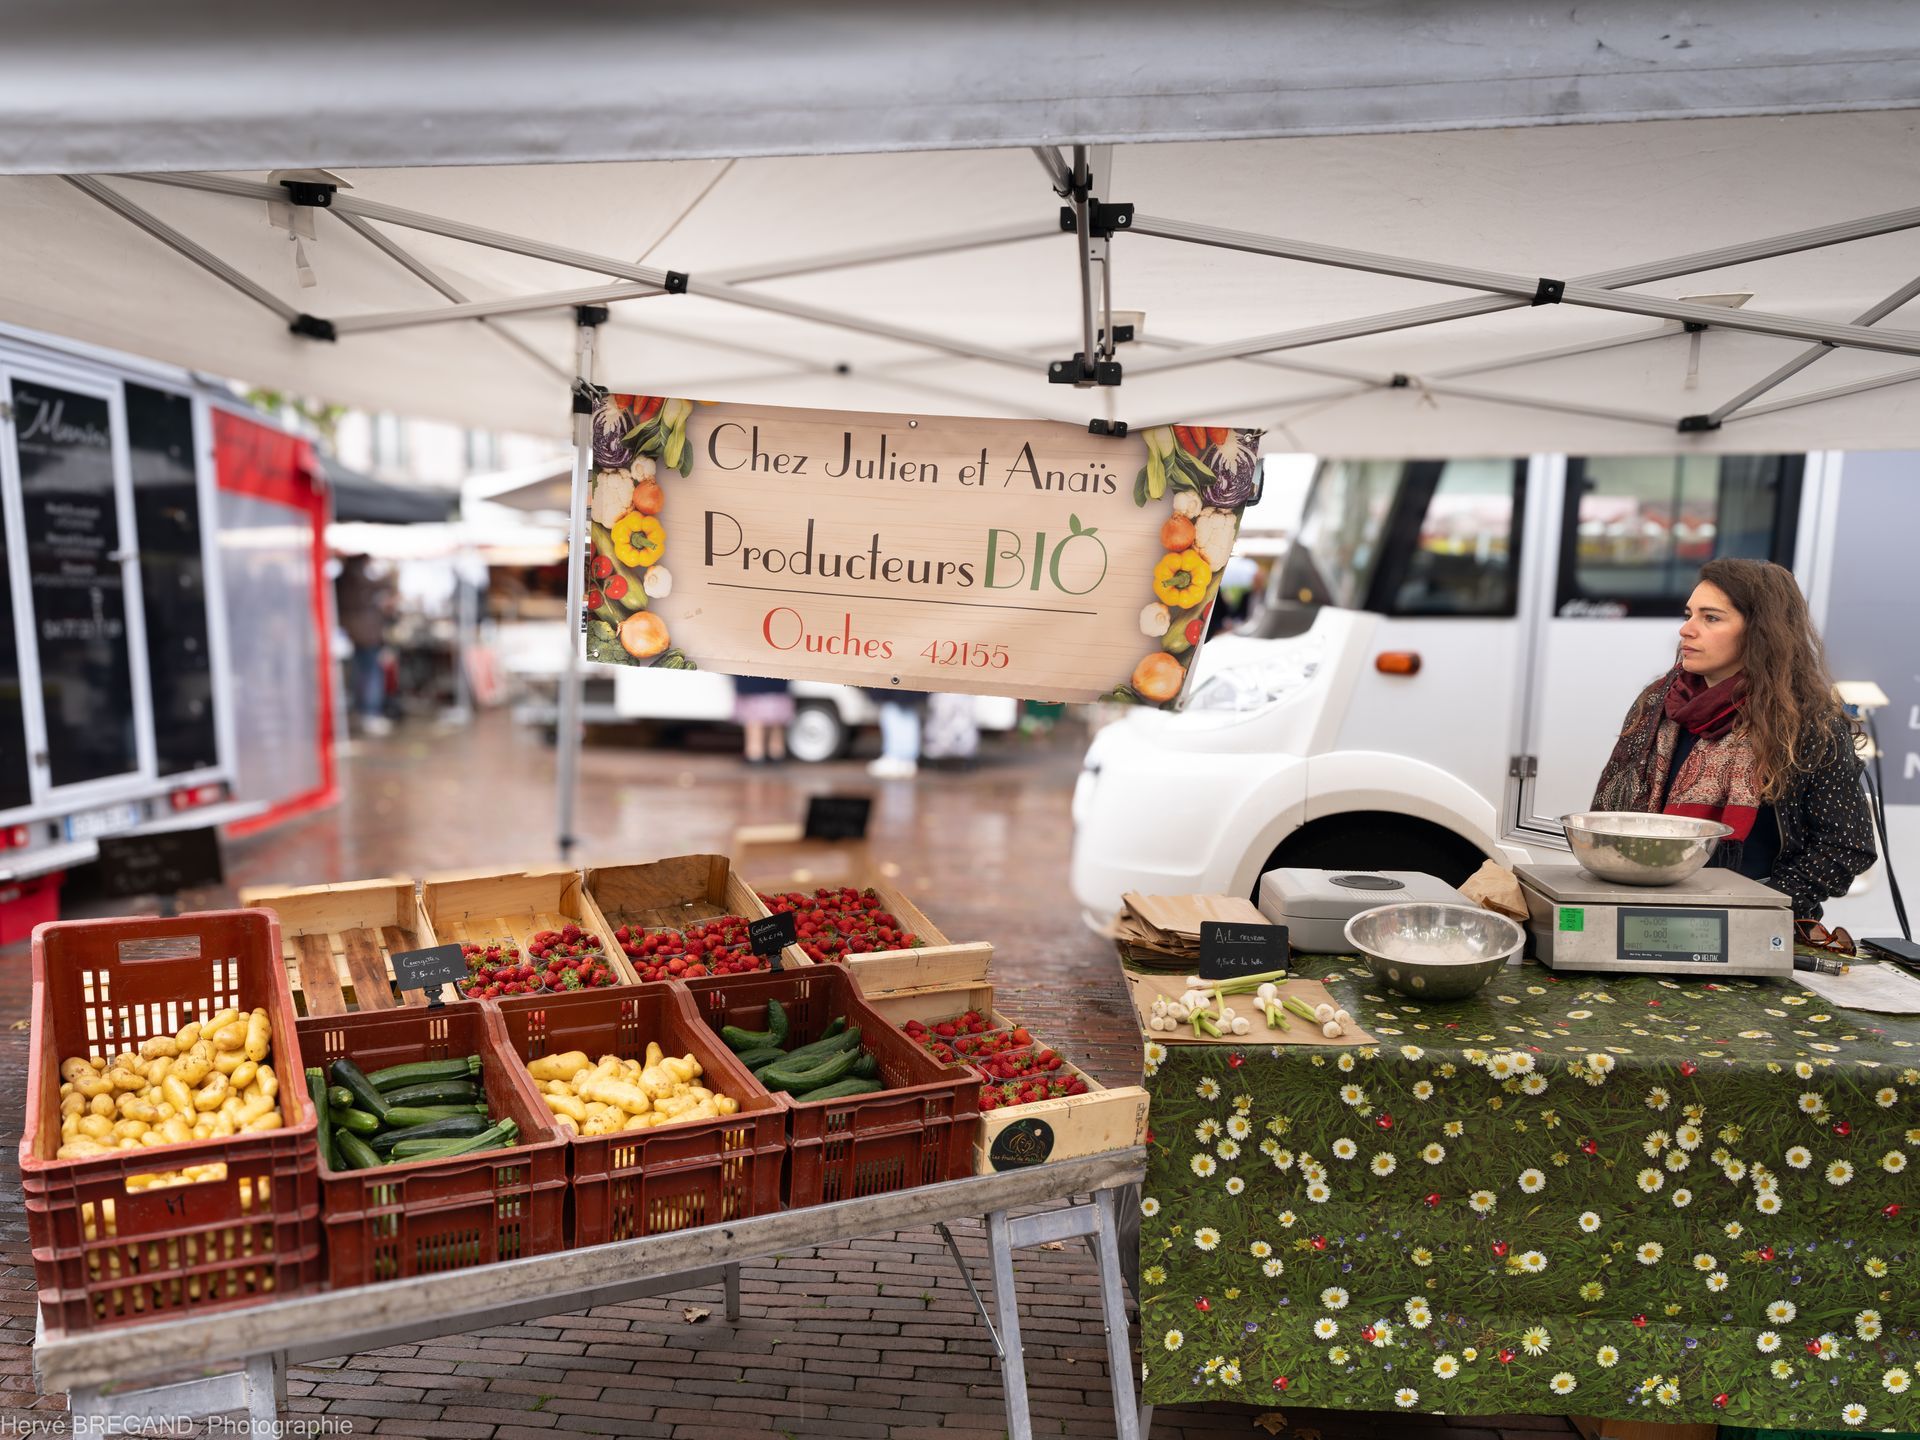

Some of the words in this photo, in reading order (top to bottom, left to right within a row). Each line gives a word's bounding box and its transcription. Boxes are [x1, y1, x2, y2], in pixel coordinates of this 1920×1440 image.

[708, 423, 808, 476] Chez
[824, 430, 938, 483] Julien
[958, 446, 988, 486] et
[1003, 441, 1118, 495] Anaïs
[705, 511, 974, 587] Producteurs
[984, 524, 1107, 596] BIO
[763, 607, 893, 659] Ouches
[920, 640, 1009, 668] 42155
